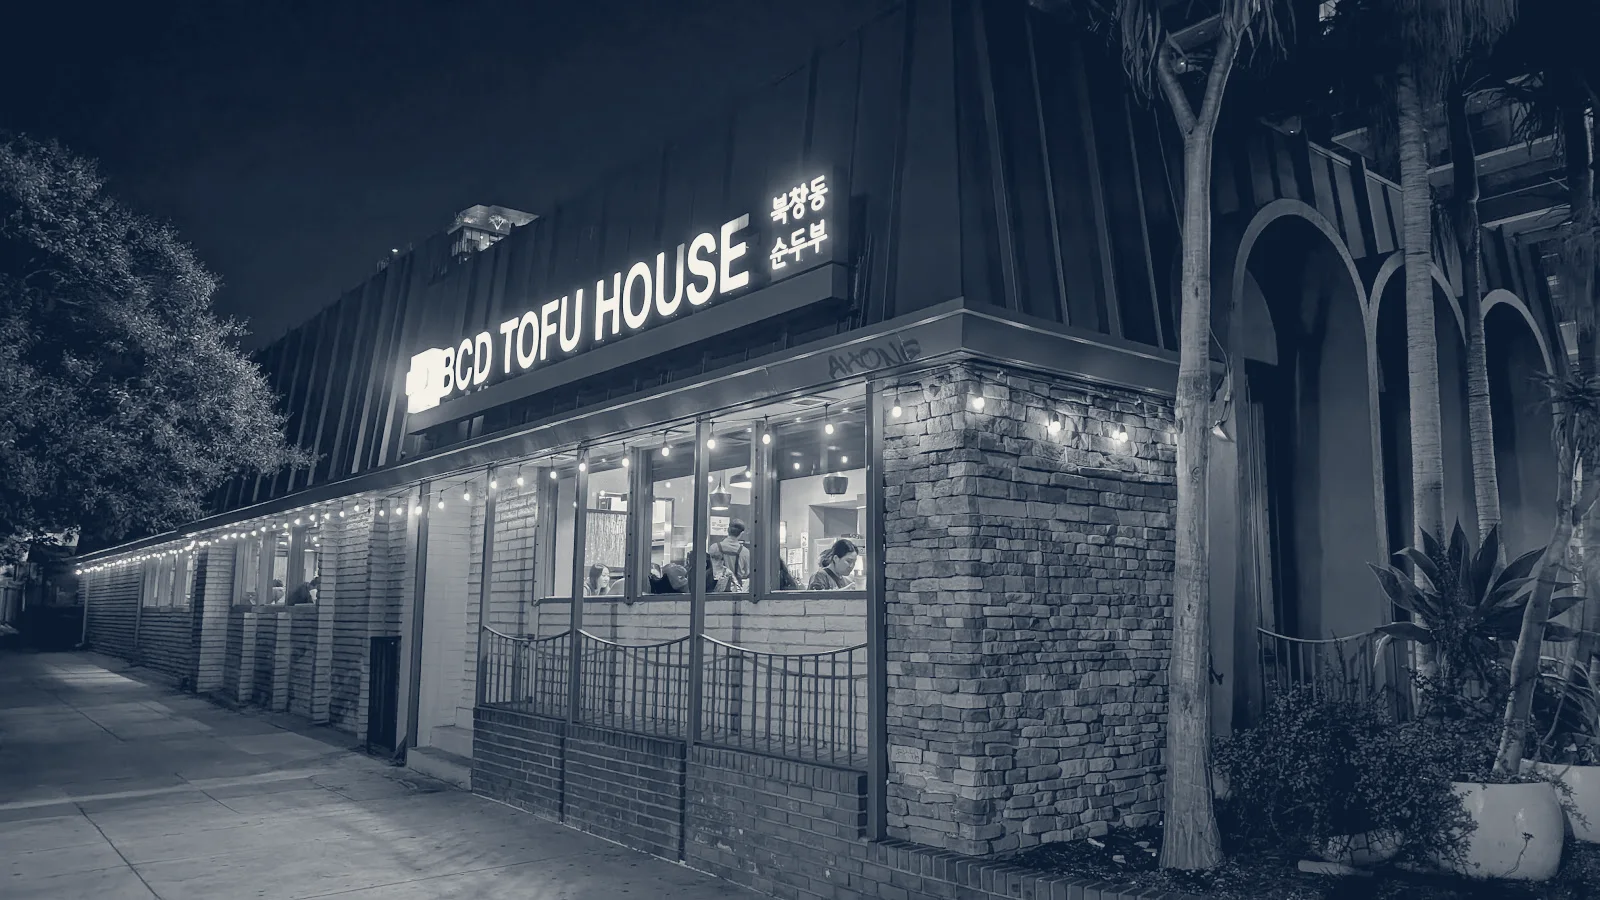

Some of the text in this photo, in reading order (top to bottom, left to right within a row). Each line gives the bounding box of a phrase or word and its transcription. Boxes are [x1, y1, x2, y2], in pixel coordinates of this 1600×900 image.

[770, 174, 829, 225] 북창동
[769, 218, 828, 270] 순두부
[439, 213, 750, 398] BCD TOFU HOUSE
